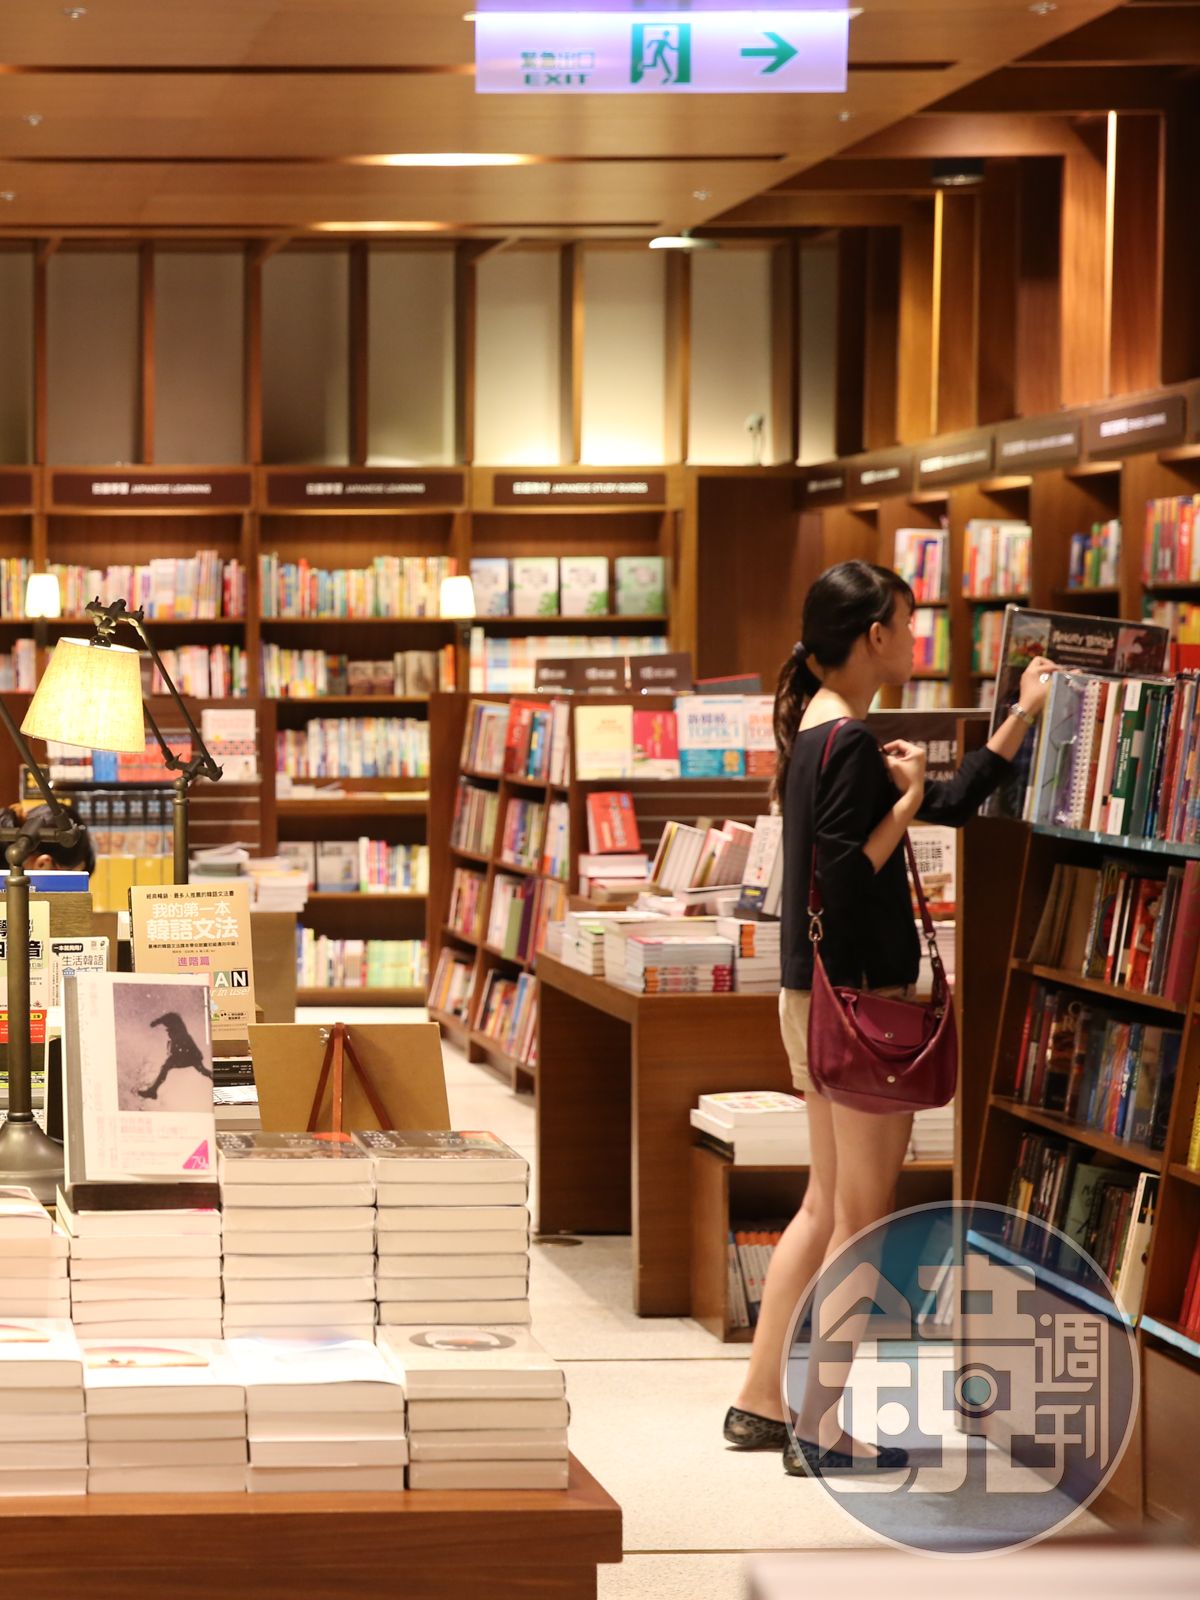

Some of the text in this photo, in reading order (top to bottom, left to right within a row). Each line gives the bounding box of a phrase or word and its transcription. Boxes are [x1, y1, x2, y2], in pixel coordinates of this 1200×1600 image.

[524, 73, 588, 86] EXIT
[152, 901, 231, 918] 我的第一本
[146, 917, 239, 941] 韓語文法
[62, 955, 104, 966] 生活韓語
[178, 956, 210, 967] 進階篇
